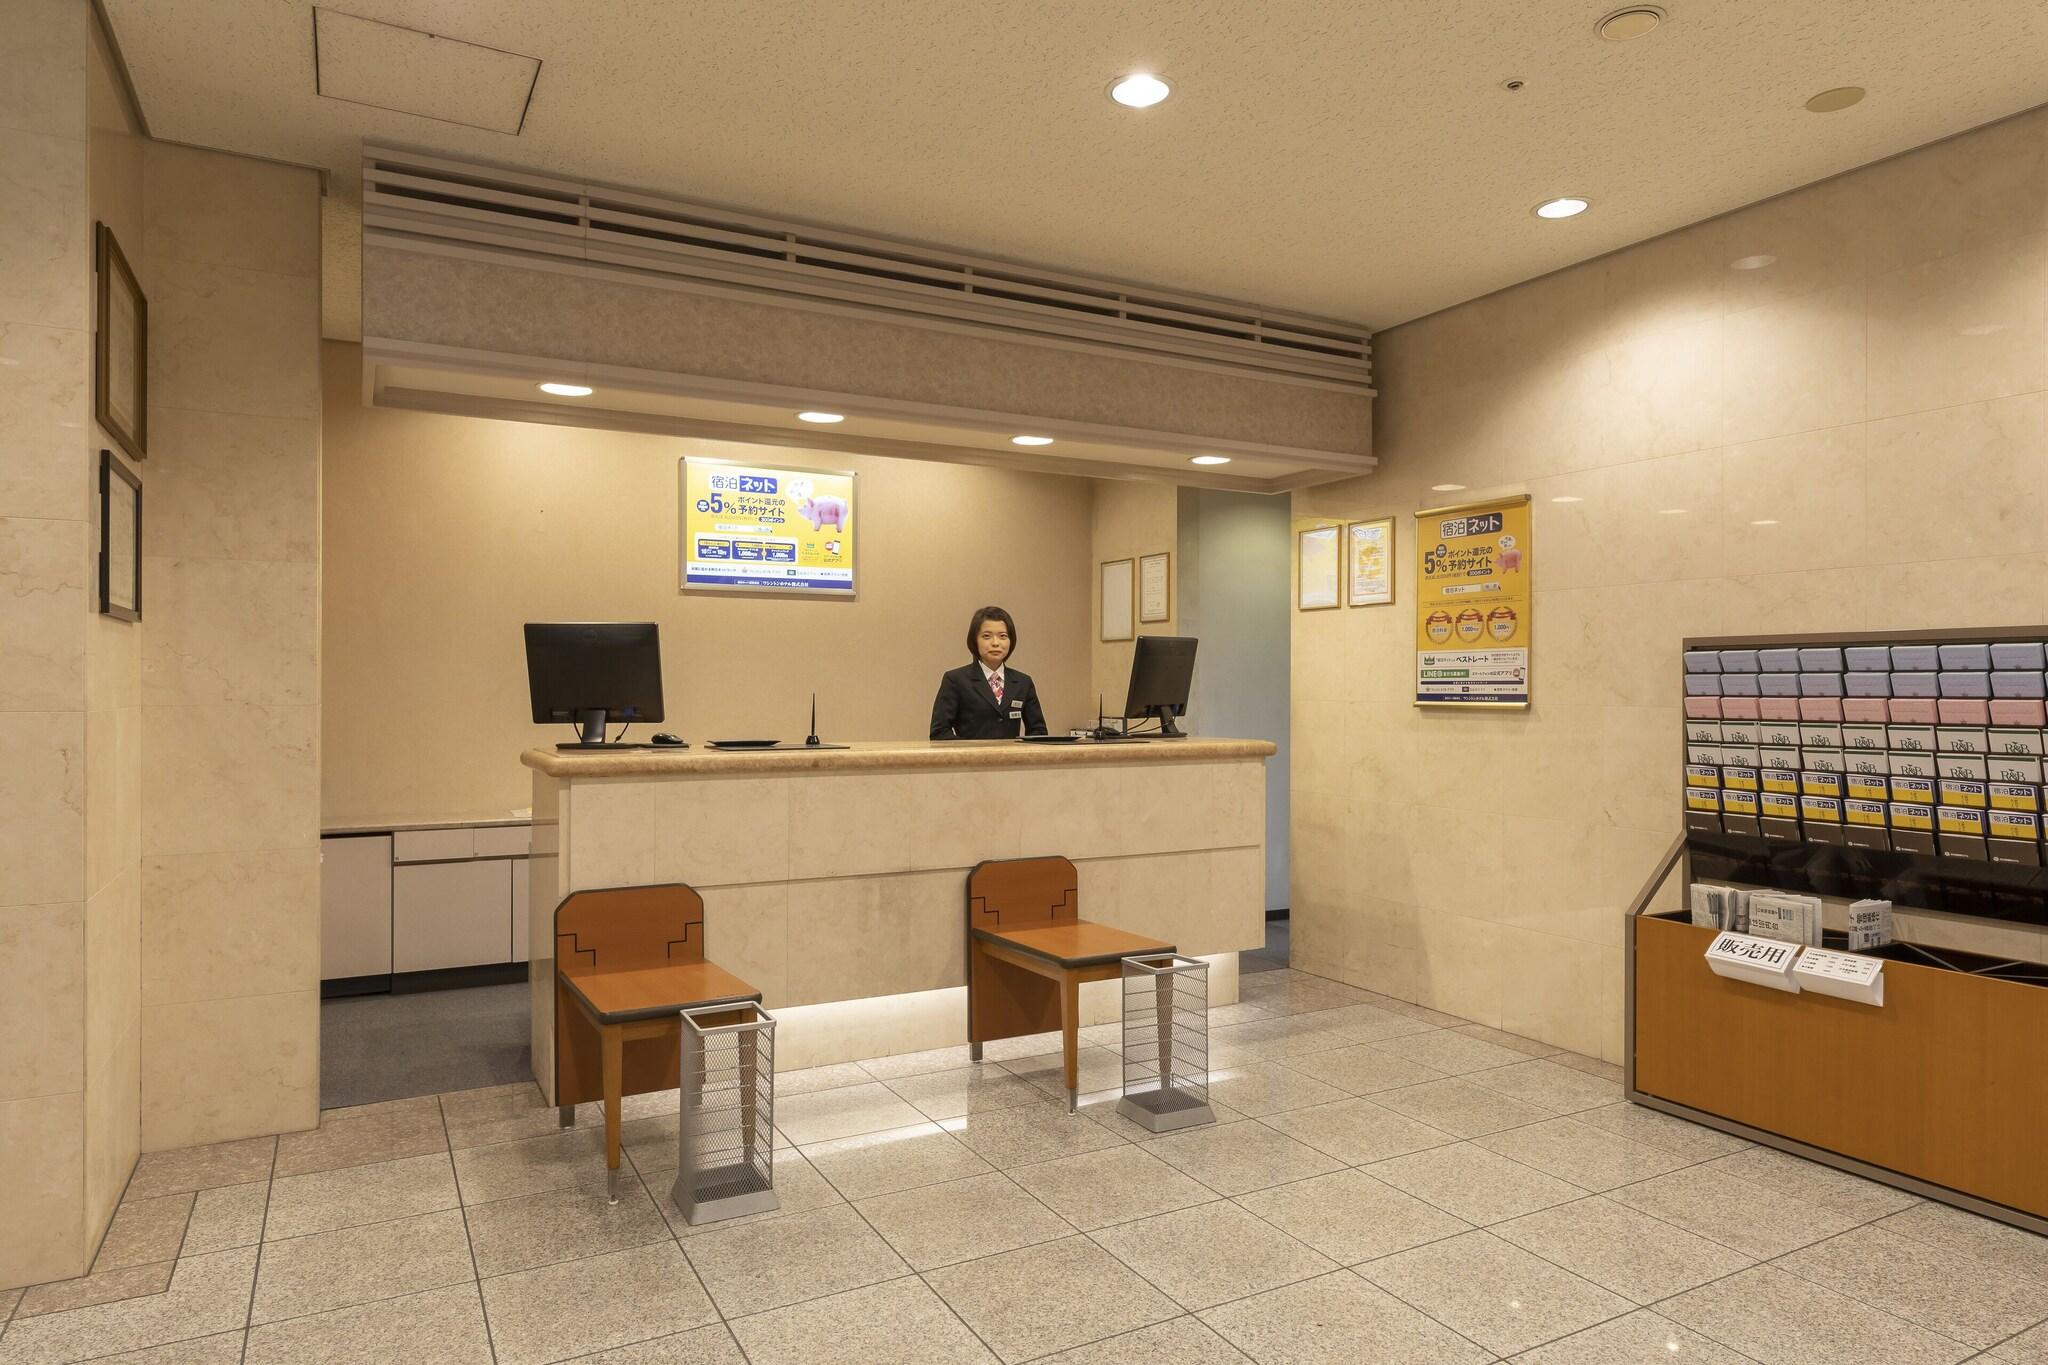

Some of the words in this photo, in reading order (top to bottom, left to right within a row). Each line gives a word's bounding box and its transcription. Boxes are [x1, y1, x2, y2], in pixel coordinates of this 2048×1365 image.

[712, 476, 776, 493] 宿泊ネット
[710, 492, 737, 515] 5%
[738, 497, 785, 507] ポイント還元の
[738, 505, 785, 517] 予約サイト
[1443, 515, 1500, 537] 宿泊ネット
[1448, 546, 1493, 559] ポイント還元の
[1424, 551, 1447, 575] 5%
[1448, 556, 1493, 572] 予約サイト
[1456, 655, 1489, 663] ベストレート
[1696, 732, 1712, 742] R&B
[1731, 733, 1749, 743] R&B
[1771, 735, 1790, 745] R&B
[1811, 736, 1830, 746] R&B
[1855, 738, 1875, 748] R&B
[1900, 739, 1922, 750] R&B
[1951, 741, 1975, 752] R&B
[2005, 743, 2030, 753] R&B
[1697, 755, 1714, 765] R&B
[1731, 757, 1749, 766] R&B
[1770, 759, 1789, 769] R&B
[1814, 761, 1834, 771] R&B
[1856, 763, 1876, 773] R&B
[1901, 765, 1923, 776] R&B
[1950, 767, 1974, 778] R&B
[2001, 770, 2026, 781] R&B
[1946, 784, 1981, 793] 宿泊ネット
[1994, 787, 2031, 796] 宿泊ネット
[1942, 810, 1978, 820] 宿泊ネット
[1993, 814, 2032, 825] 宿泊ネット
[1716, 938, 1787, 964] 販売用
